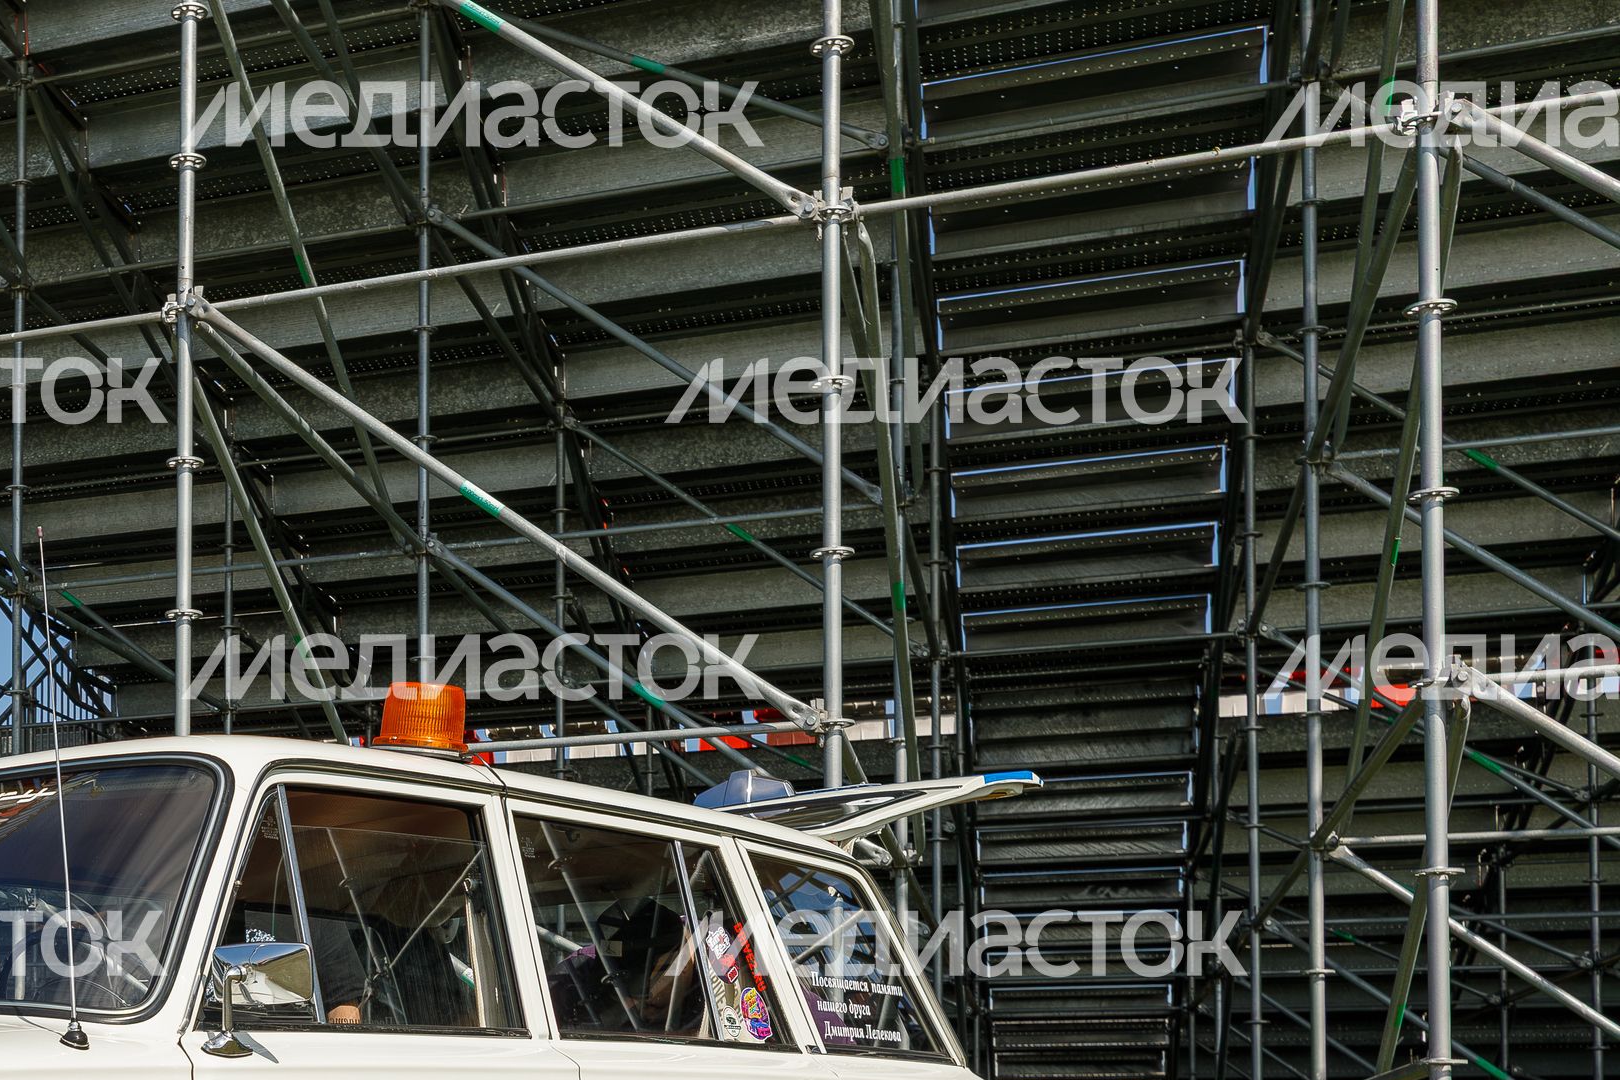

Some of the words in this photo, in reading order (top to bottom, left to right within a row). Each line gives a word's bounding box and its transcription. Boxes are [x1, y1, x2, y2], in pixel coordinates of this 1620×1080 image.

[810, 970, 869, 993] Посвящается
[871, 982, 903, 997] памяти
[816, 1000, 848, 1014] нашего
[848, 998, 871, 1019] друга
[823, 1020, 865, 1042] Дмитрия
[865, 1023, 902, 1042] Лелекова
